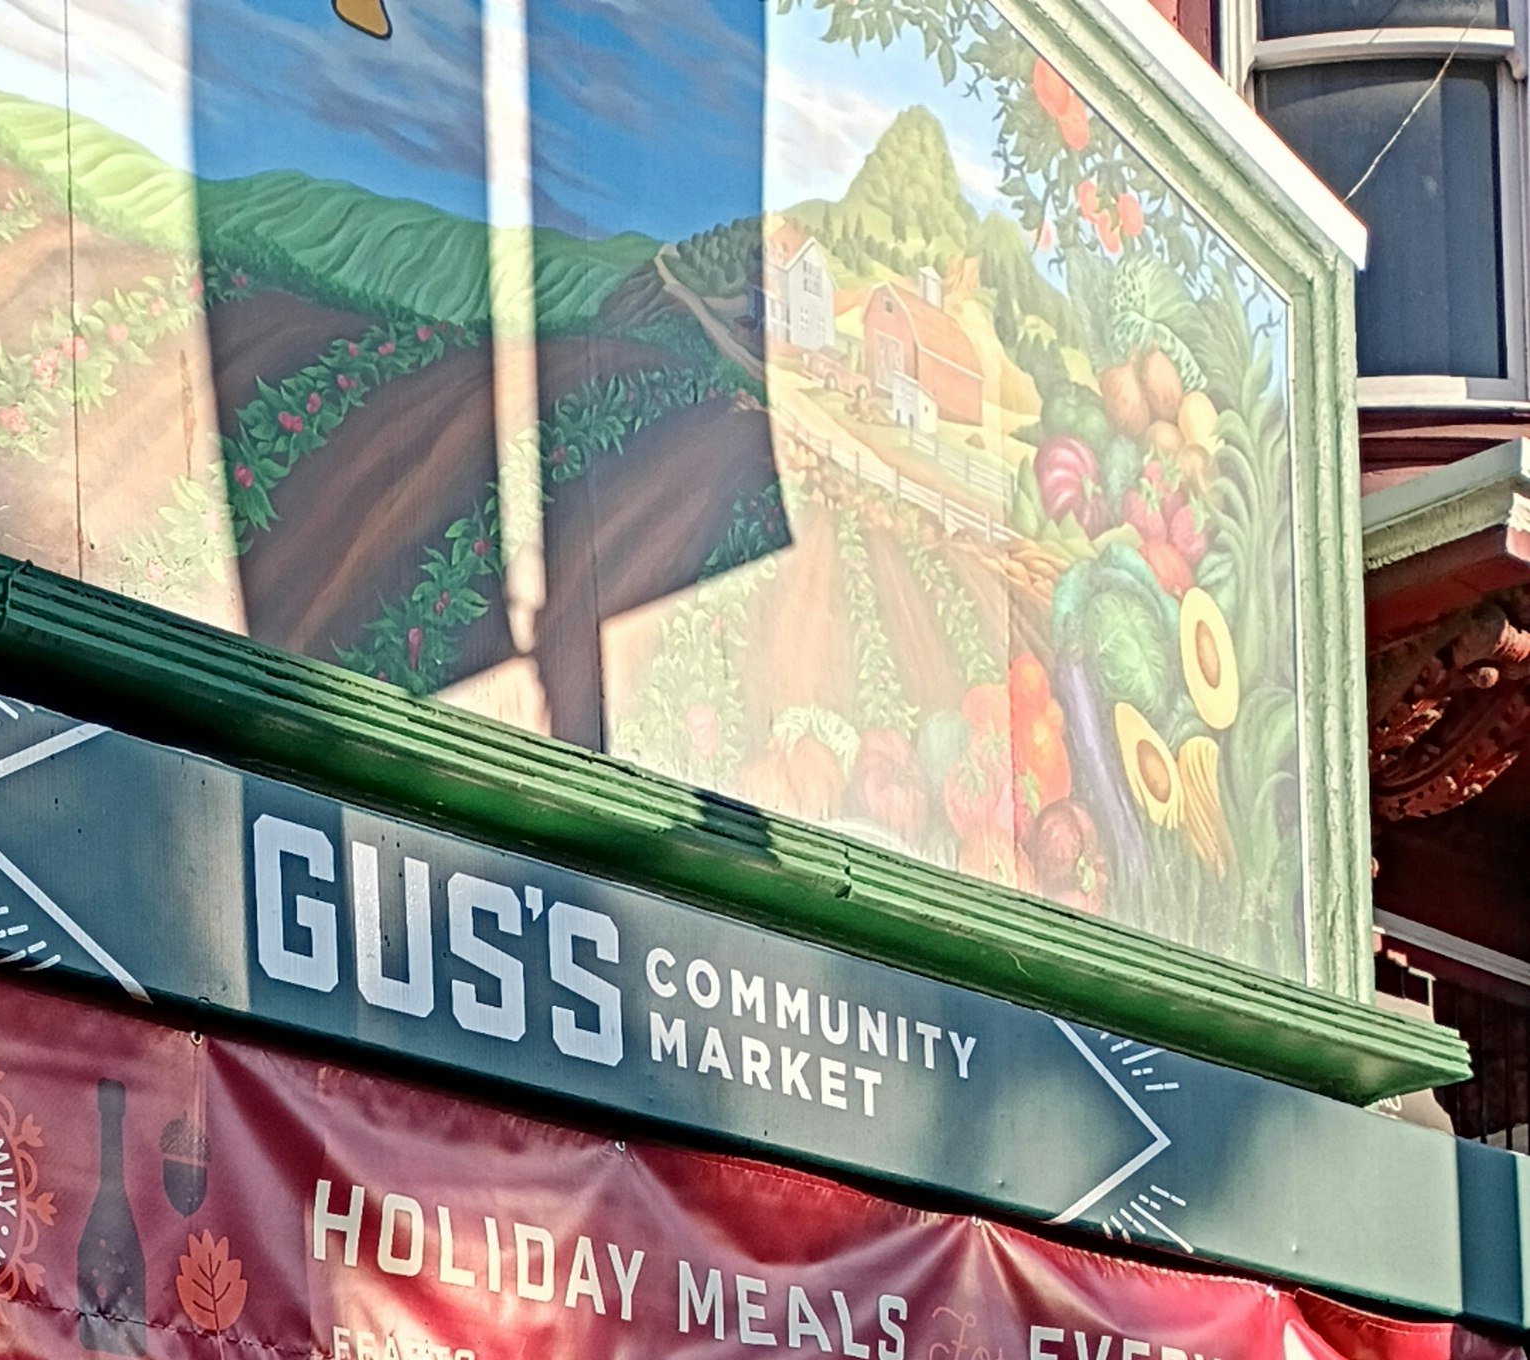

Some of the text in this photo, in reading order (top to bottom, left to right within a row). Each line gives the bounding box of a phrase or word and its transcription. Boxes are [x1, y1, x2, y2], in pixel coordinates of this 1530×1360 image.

[253, 814, 623, 1066] GUS'S
[646, 948, 977, 1080] COMMUNITY
[649, 1011, 881, 1118] MARKET
[313, 1179, 645, 1321] HOLIDAY
